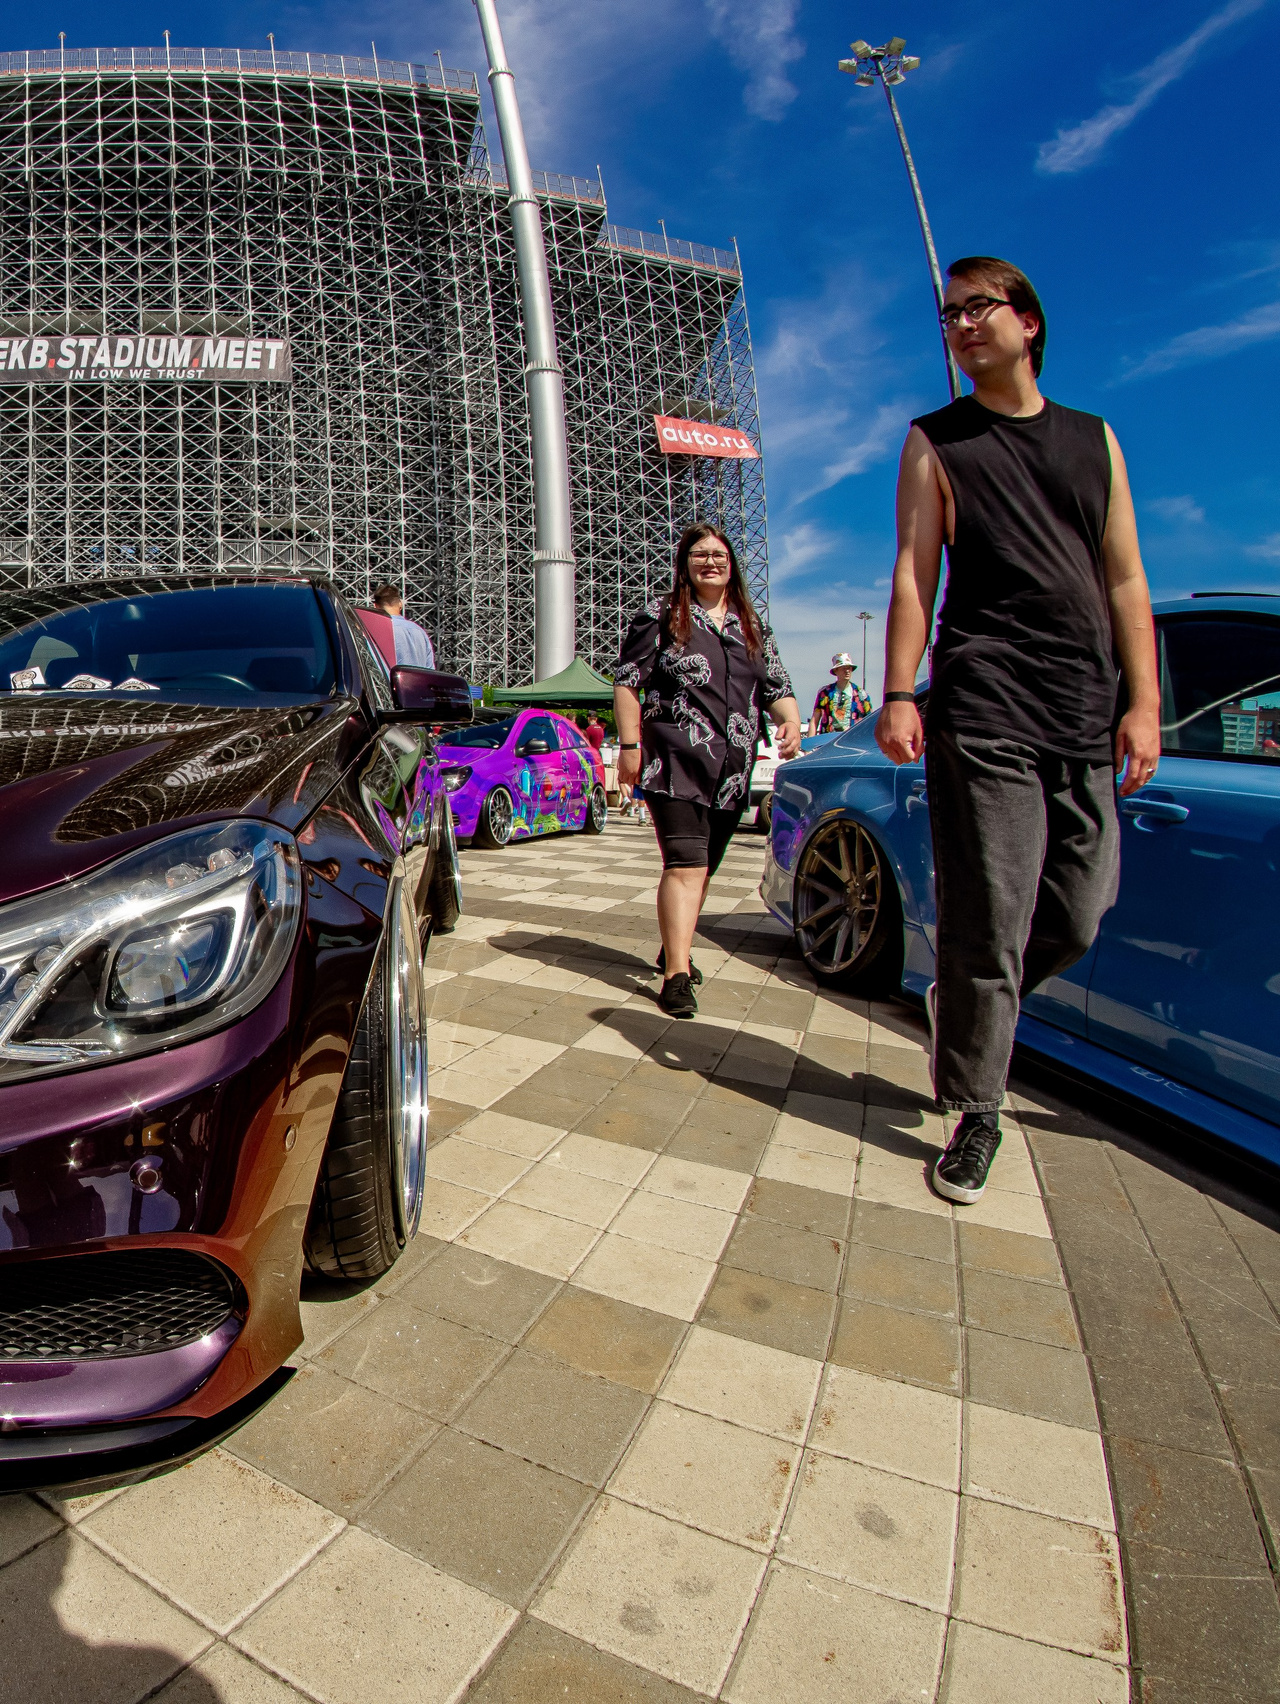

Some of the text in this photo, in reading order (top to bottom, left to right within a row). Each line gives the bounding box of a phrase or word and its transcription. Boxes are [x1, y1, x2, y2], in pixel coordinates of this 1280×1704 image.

[69, 369, 205, 379] IN LOW WE TRUST
[662, 427, 749, 449] auto.ru
